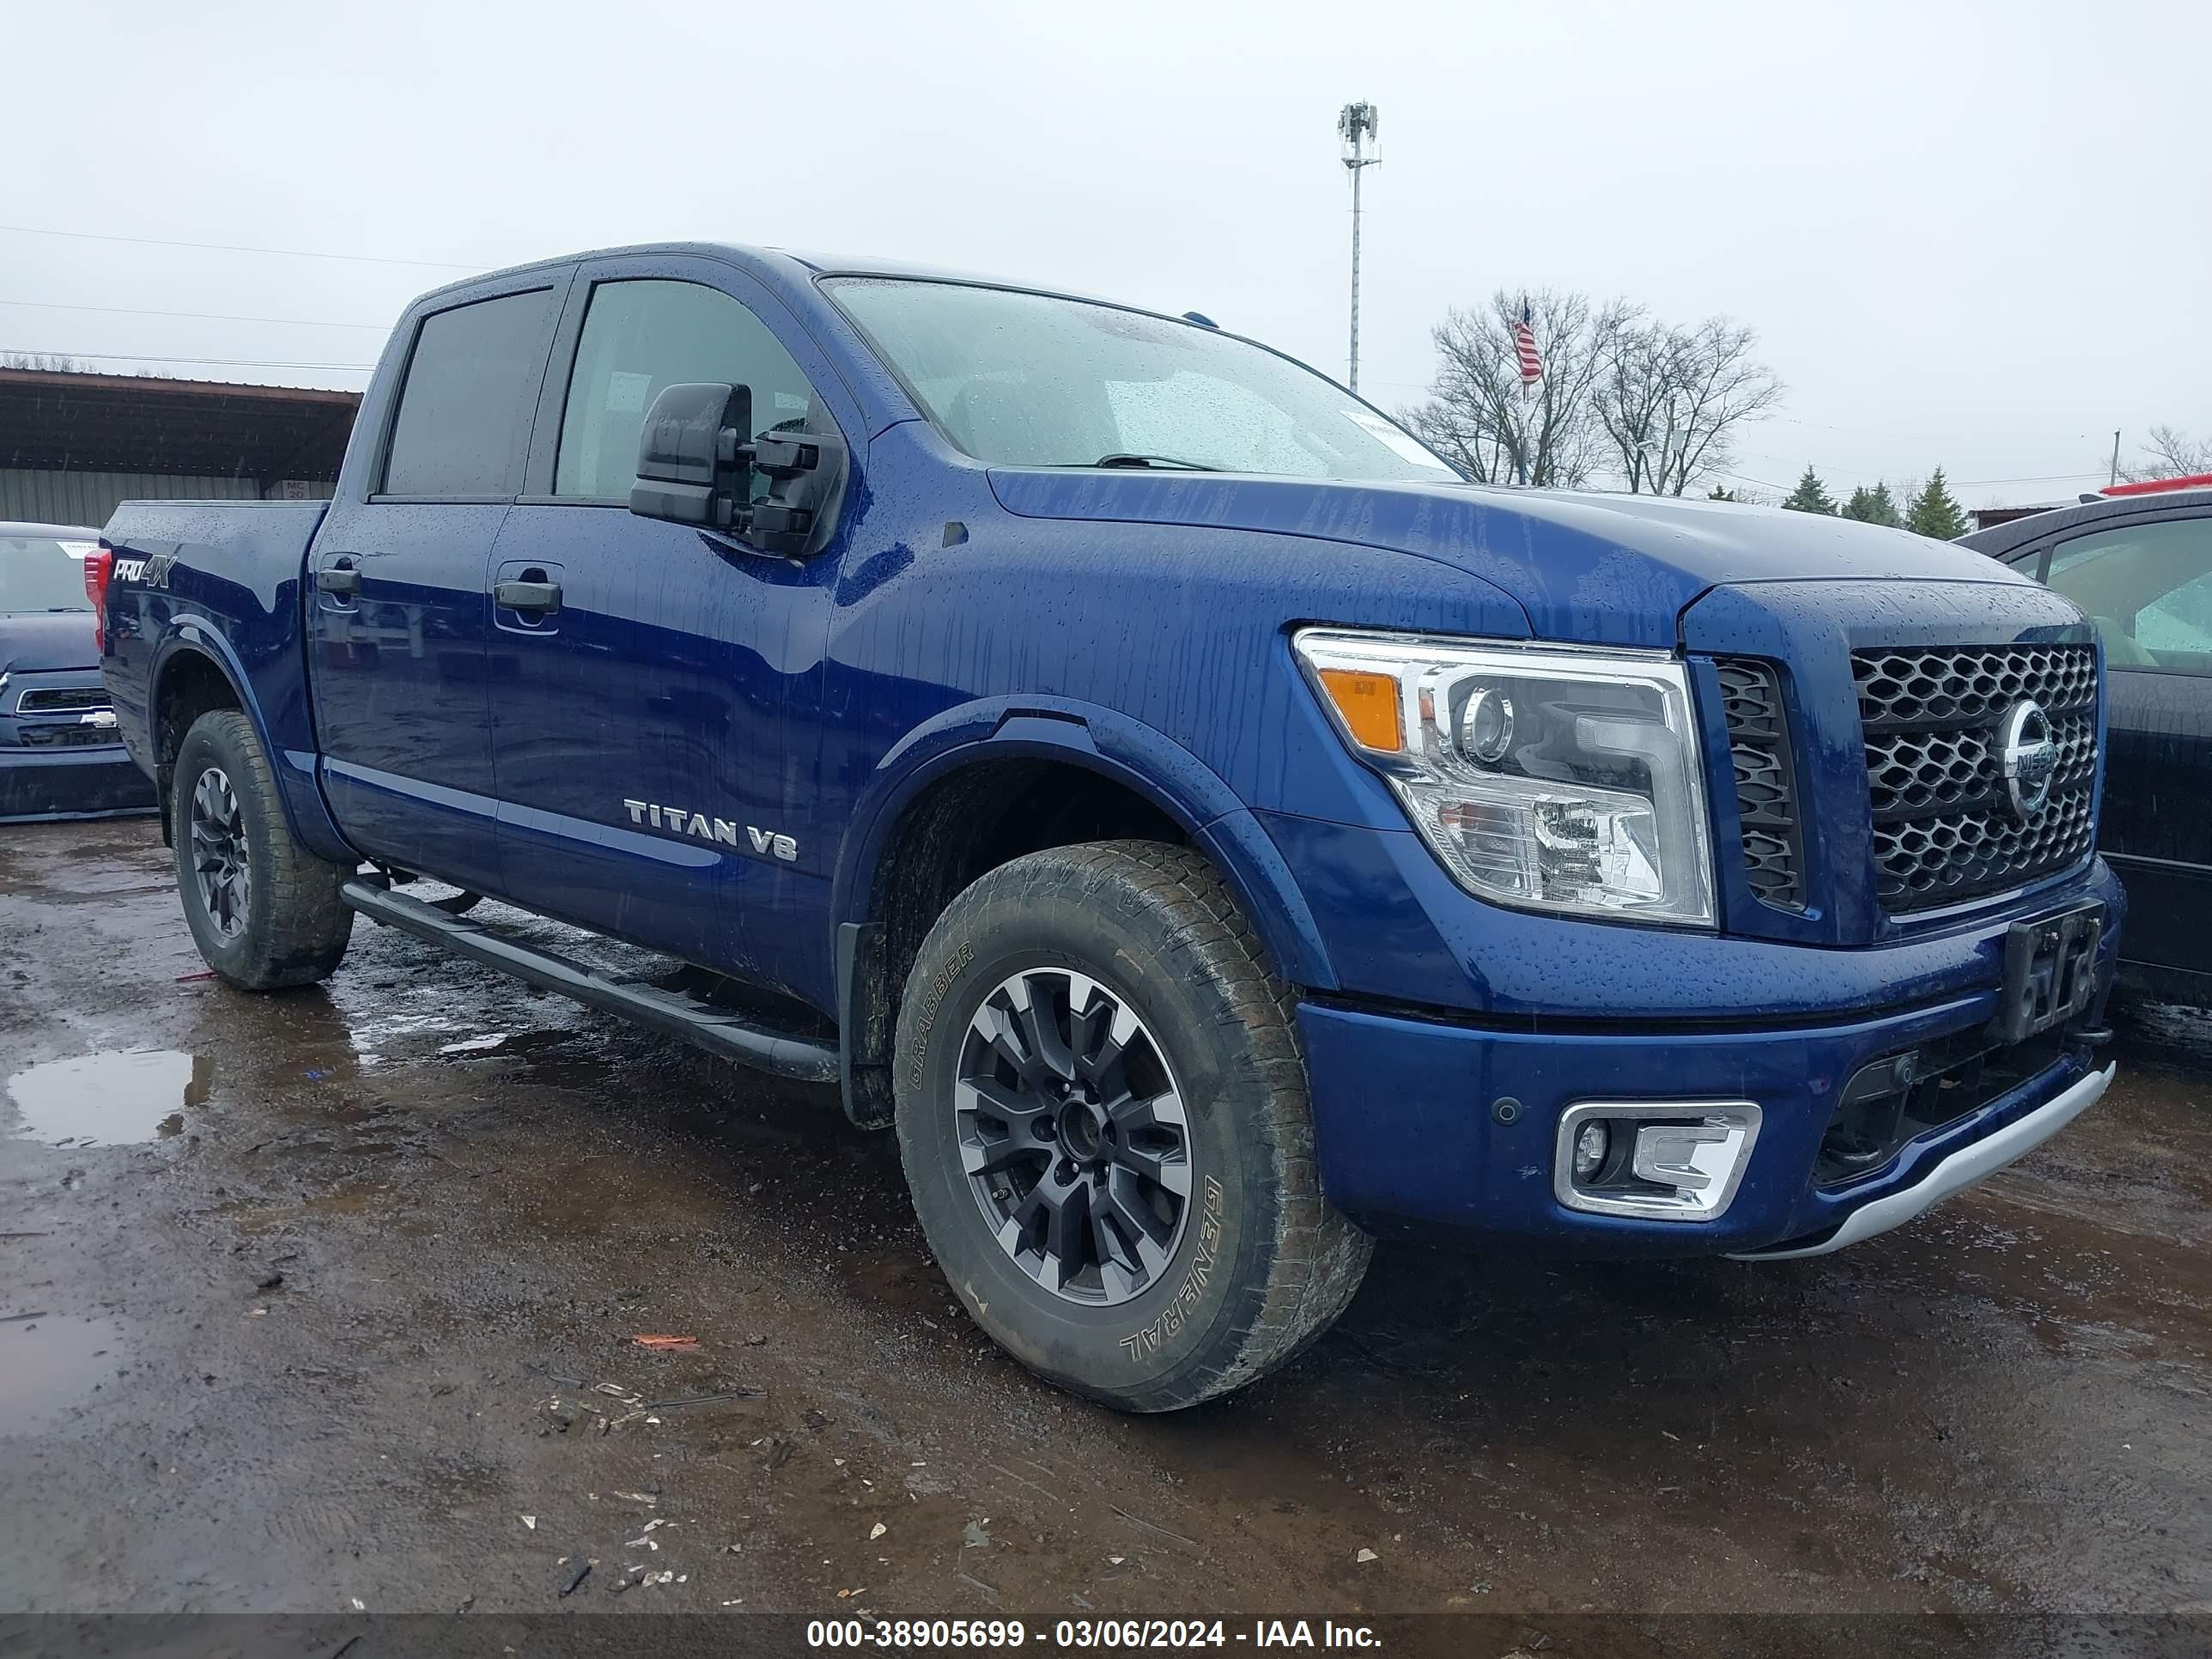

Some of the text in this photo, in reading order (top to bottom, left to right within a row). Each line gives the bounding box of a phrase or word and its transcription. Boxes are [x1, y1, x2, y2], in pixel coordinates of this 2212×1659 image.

[2017, 753, 2054, 772] NISSA
[623, 799, 798, 862] TITAN V8
[909, 940, 975, 1091] GRABBER
[1119, 1174, 1224, 1362] GENERAL
